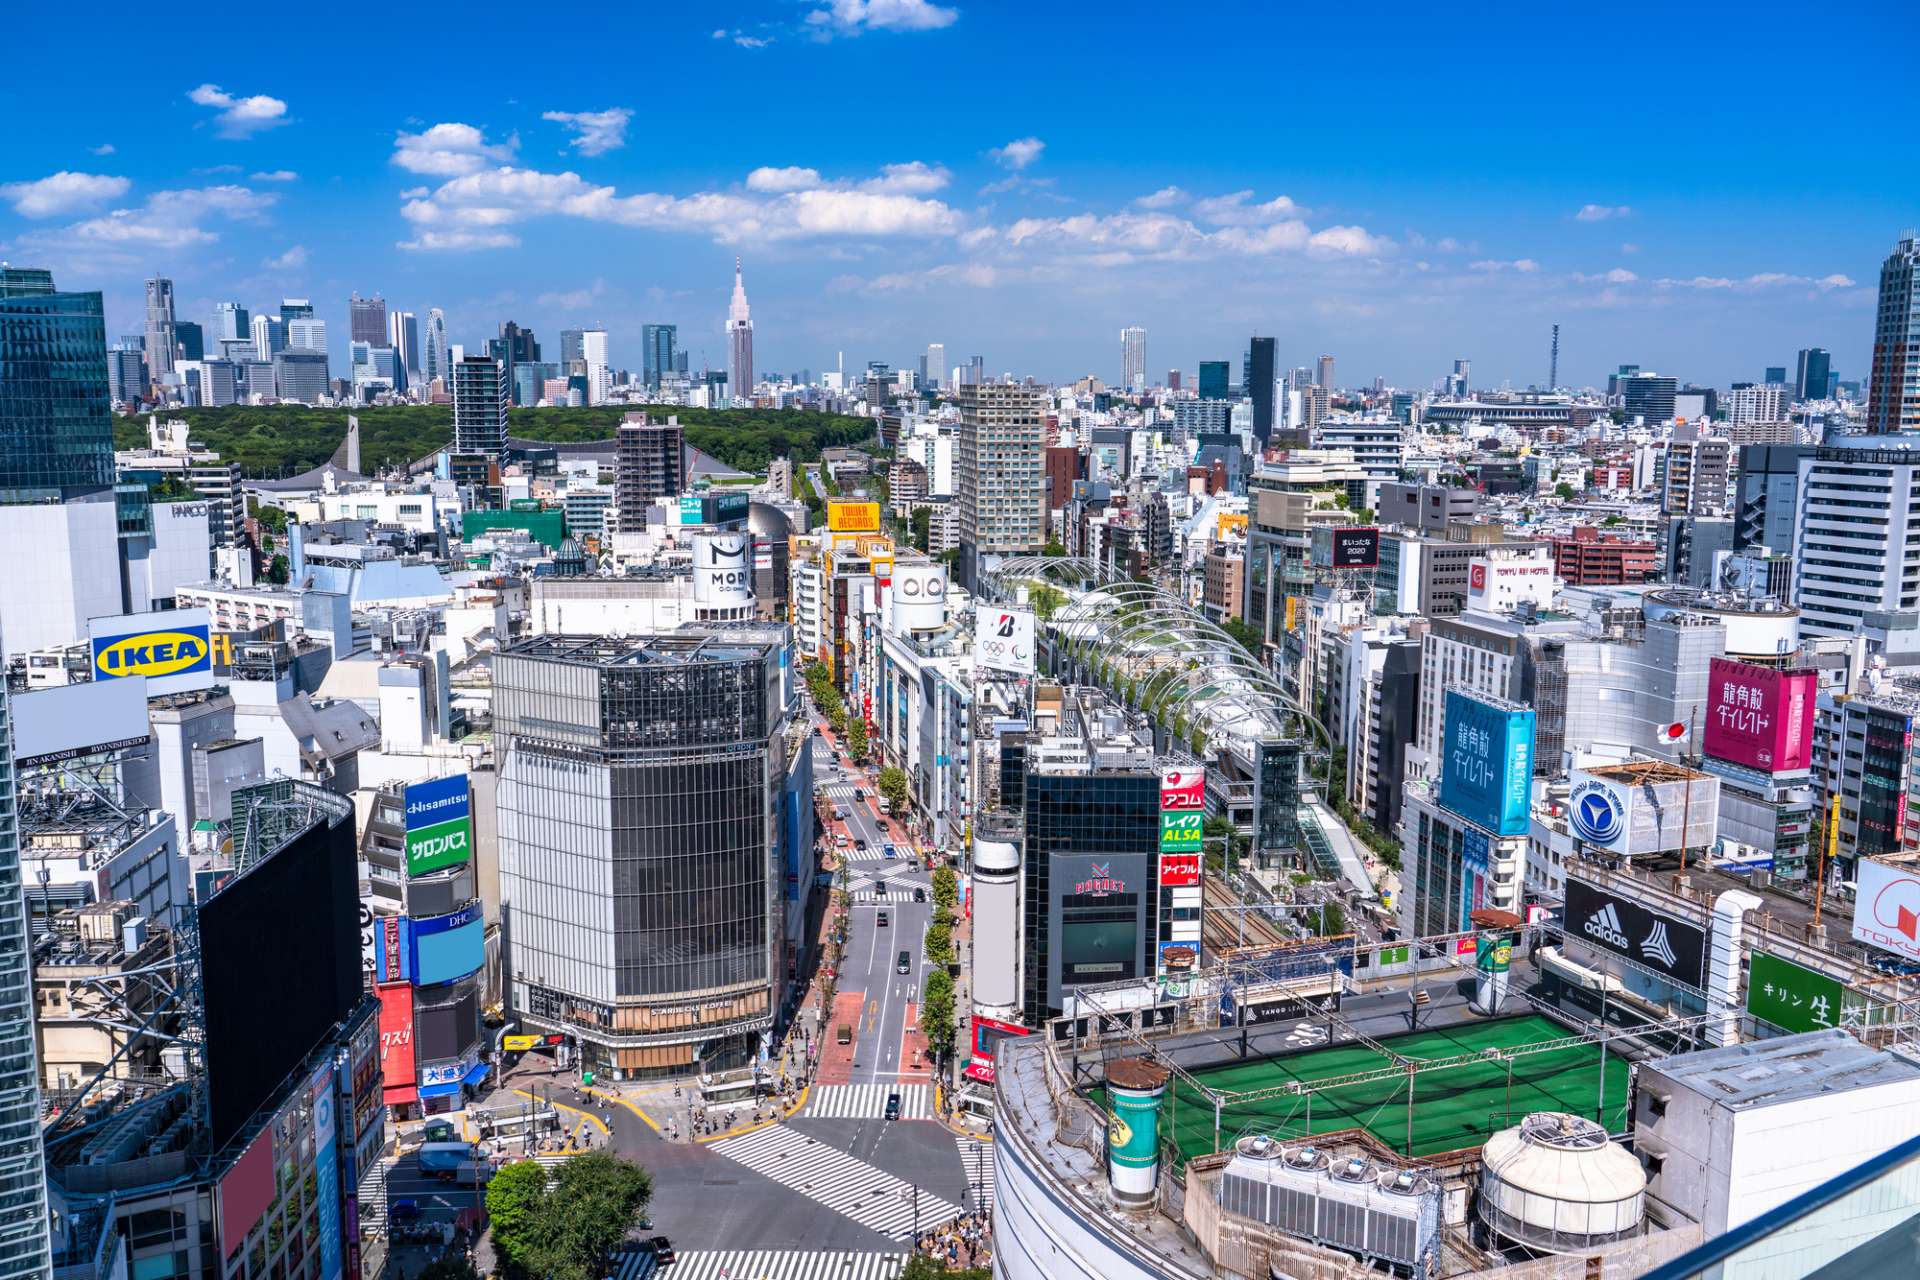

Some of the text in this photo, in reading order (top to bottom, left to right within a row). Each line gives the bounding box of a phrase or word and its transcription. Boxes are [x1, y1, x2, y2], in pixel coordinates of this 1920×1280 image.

[841, 506, 868, 517] TOWER
[838, 517, 874, 529] RECORDS
[1529, 567, 1550, 575] HOTEL
[106, 639, 200, 669] IKEA
[1723, 682, 1764, 711] 龍角散
[1716, 704, 1769, 735] ダイレクト
[1453, 750, 1495, 789] ダイレクト
[406, 793, 467, 814] Hisamitsu
[1164, 793, 1201, 807] アコム
[1164, 815, 1200, 828] レイク
[1162, 829, 1200, 841] ALSA
[411, 831, 466, 861] サロンパス
[1162, 864, 1197, 875] アイフル
[1584, 921, 1629, 949] adidas
[1763, 982, 1803, 1006] キリン
[725, 1020, 767, 1036] TSUTAYA
[382, 1022, 413, 1060] クスリ
